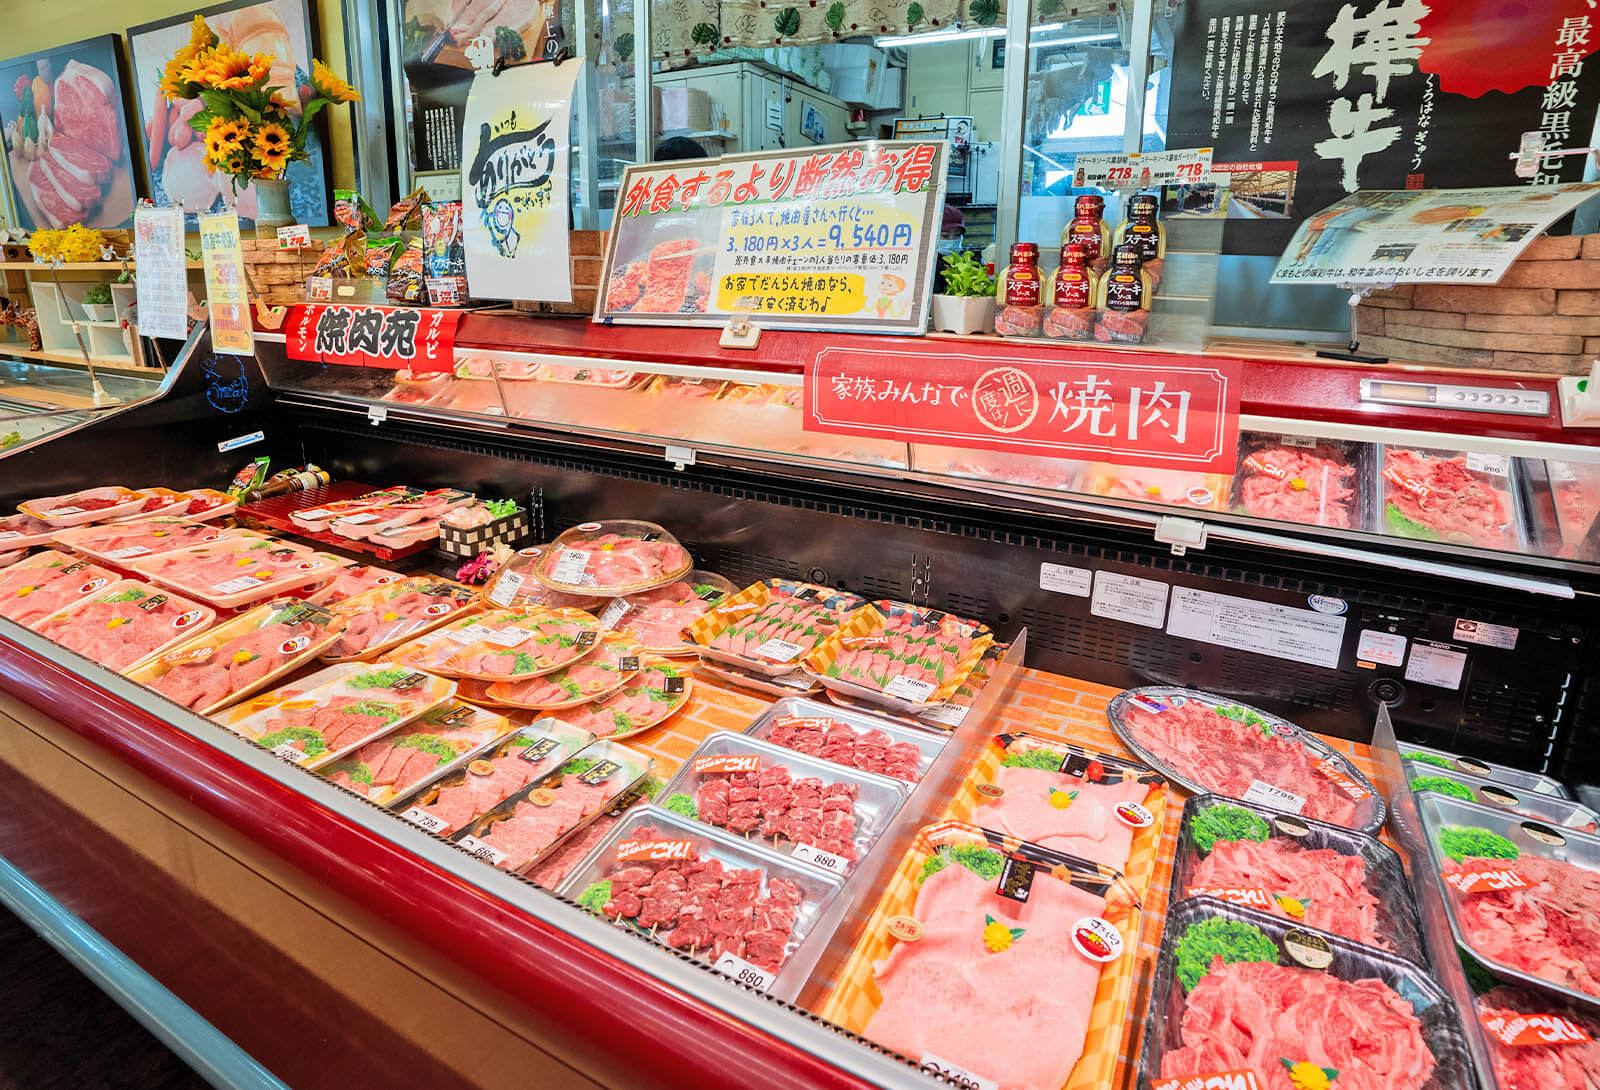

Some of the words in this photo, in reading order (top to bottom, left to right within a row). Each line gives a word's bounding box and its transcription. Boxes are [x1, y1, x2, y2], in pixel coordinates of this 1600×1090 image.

[1108, 167, 1132, 180] 278
[1175, 162, 1203, 178] 278
[621, 144, 938, 218] 外食するより断然お得
[1070, 233, 1101, 245] ステーキ
[1125, 233, 1159, 245] ステーキ
[1007, 280, 1039, 292] ステーキ
[1056, 281, 1089, 293] ステーキ
[1108, 283, 1142, 296] ステーキ
[297, 304, 316, 352] ホルモン
[315, 306, 421, 359] 焼肉苑
[425, 311, 443, 359] カルビ
[830, 370, 969, 409] 家族みんなで
[1047, 373, 1193, 445] 焼肉
[418, 816, 439, 829] 739
[813, 854, 836, 868] 880
[738, 968, 764, 988] 880
